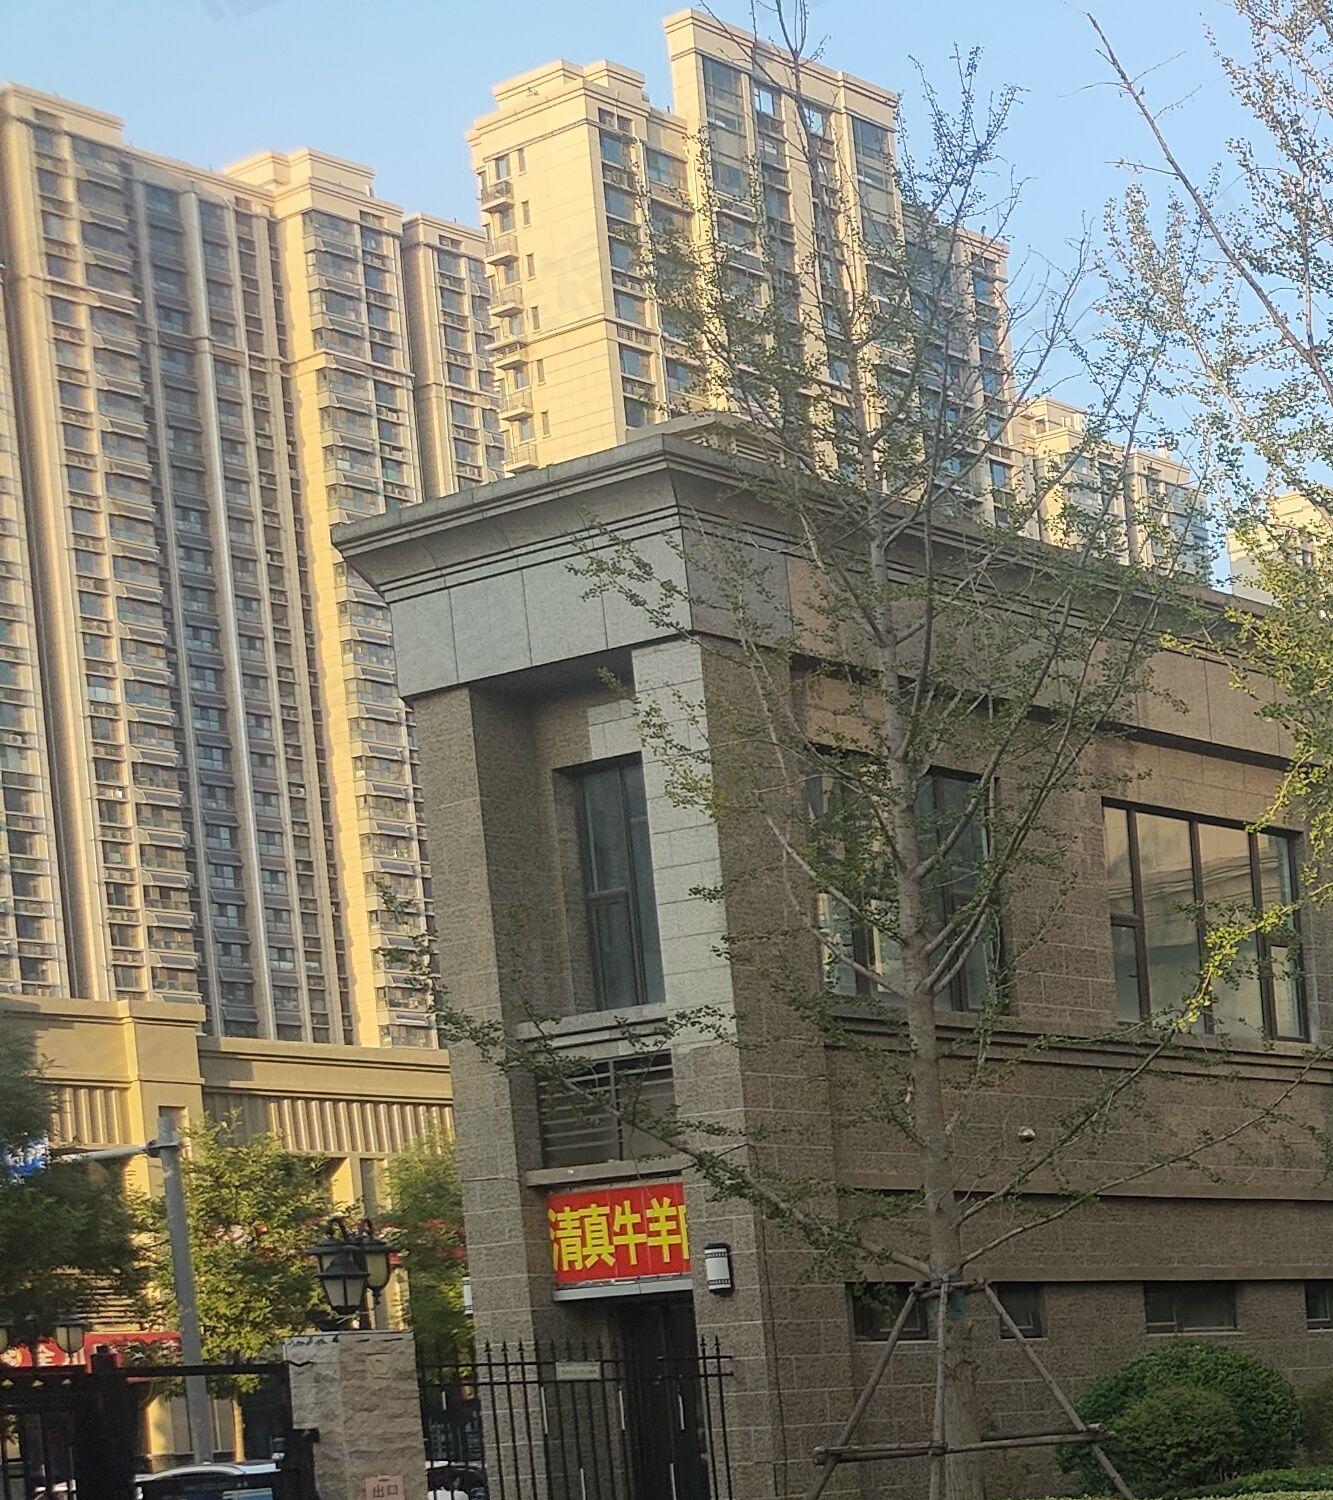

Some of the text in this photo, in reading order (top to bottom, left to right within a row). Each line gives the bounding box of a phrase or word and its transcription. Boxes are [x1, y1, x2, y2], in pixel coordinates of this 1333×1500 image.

[548, 1197, 691, 1271] 清真牛羊
[373, 1485, 398, 1498] 出口
